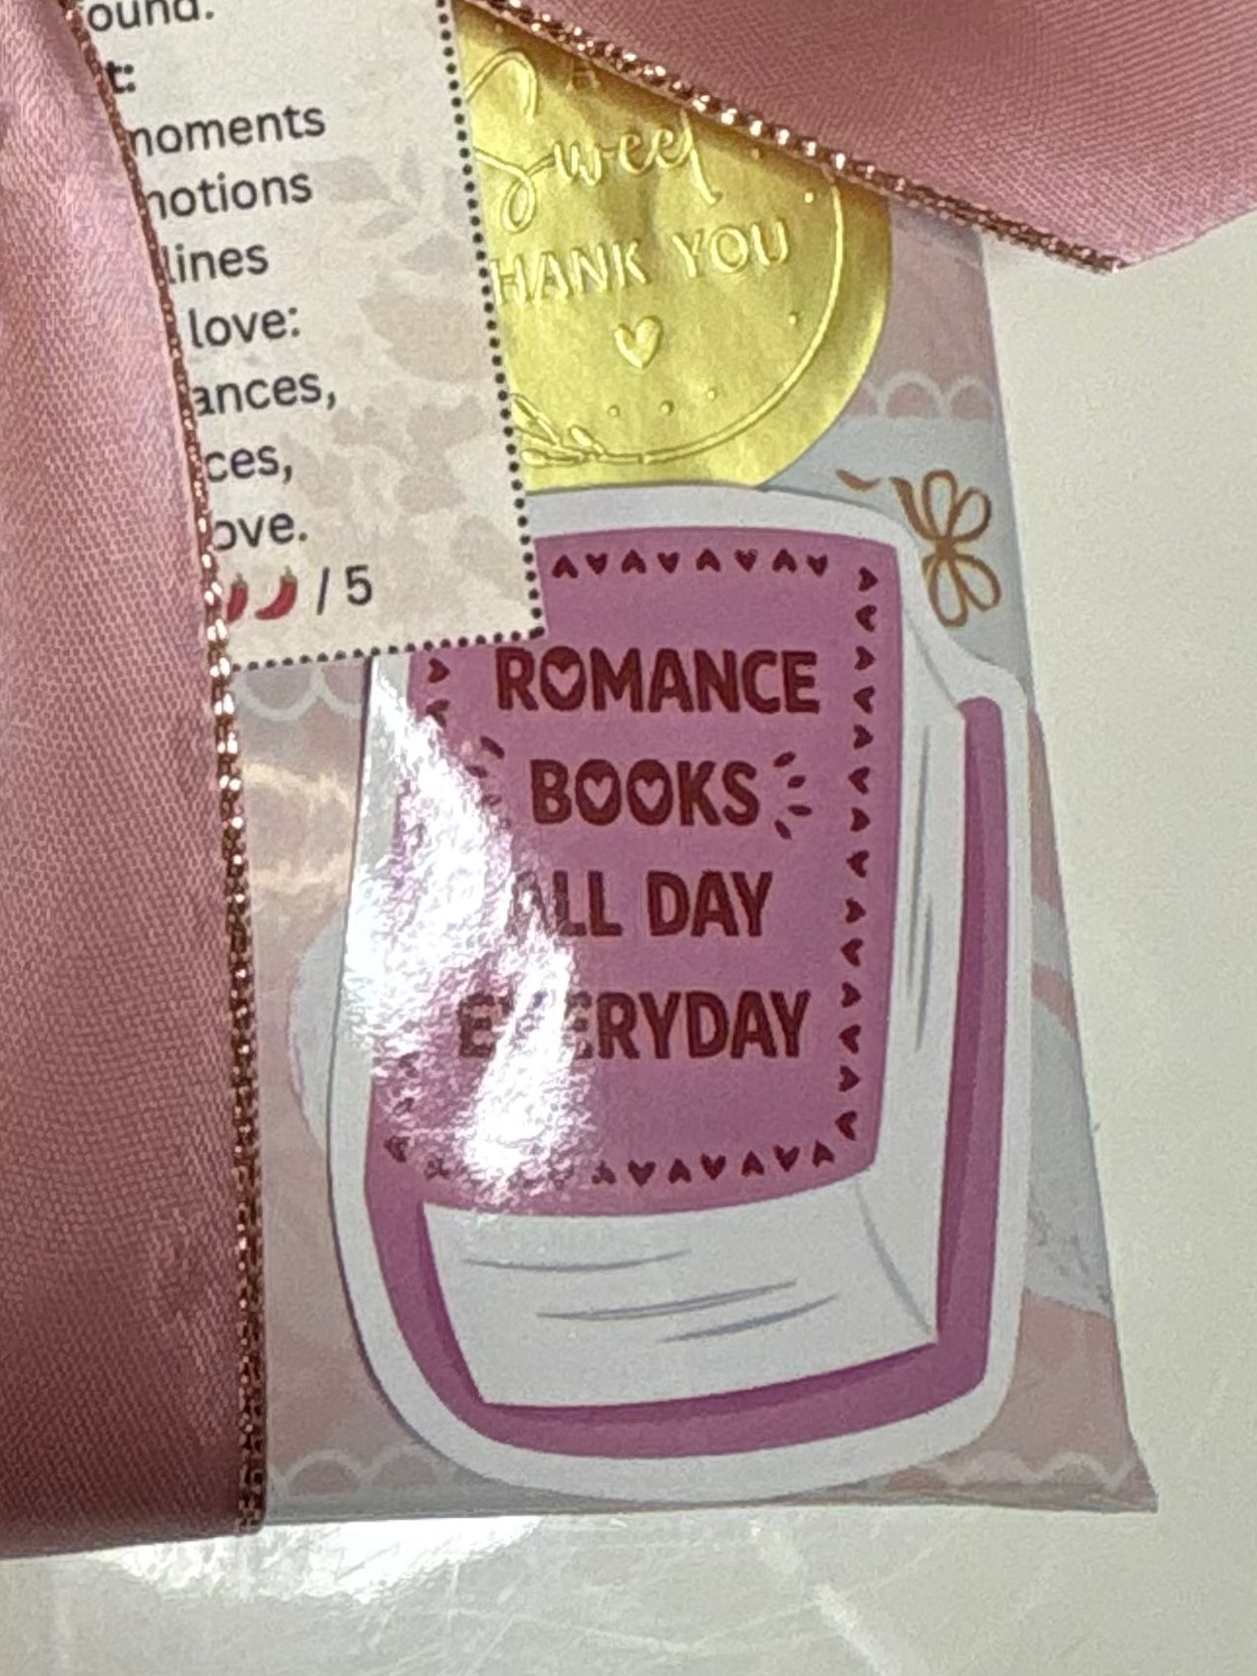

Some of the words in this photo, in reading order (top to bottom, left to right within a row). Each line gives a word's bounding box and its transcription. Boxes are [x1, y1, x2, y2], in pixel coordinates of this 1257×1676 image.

[671, 216, 791, 279] YOU
[188, 306, 301, 349] love:
[345, 564, 374, 606] 5
[494, 645, 821, 715] ROMANCE
[530, 758, 761, 827] BOOKS
[646, 869, 774, 938] DAY
[456, 988, 812, 1061] EERYDAY
